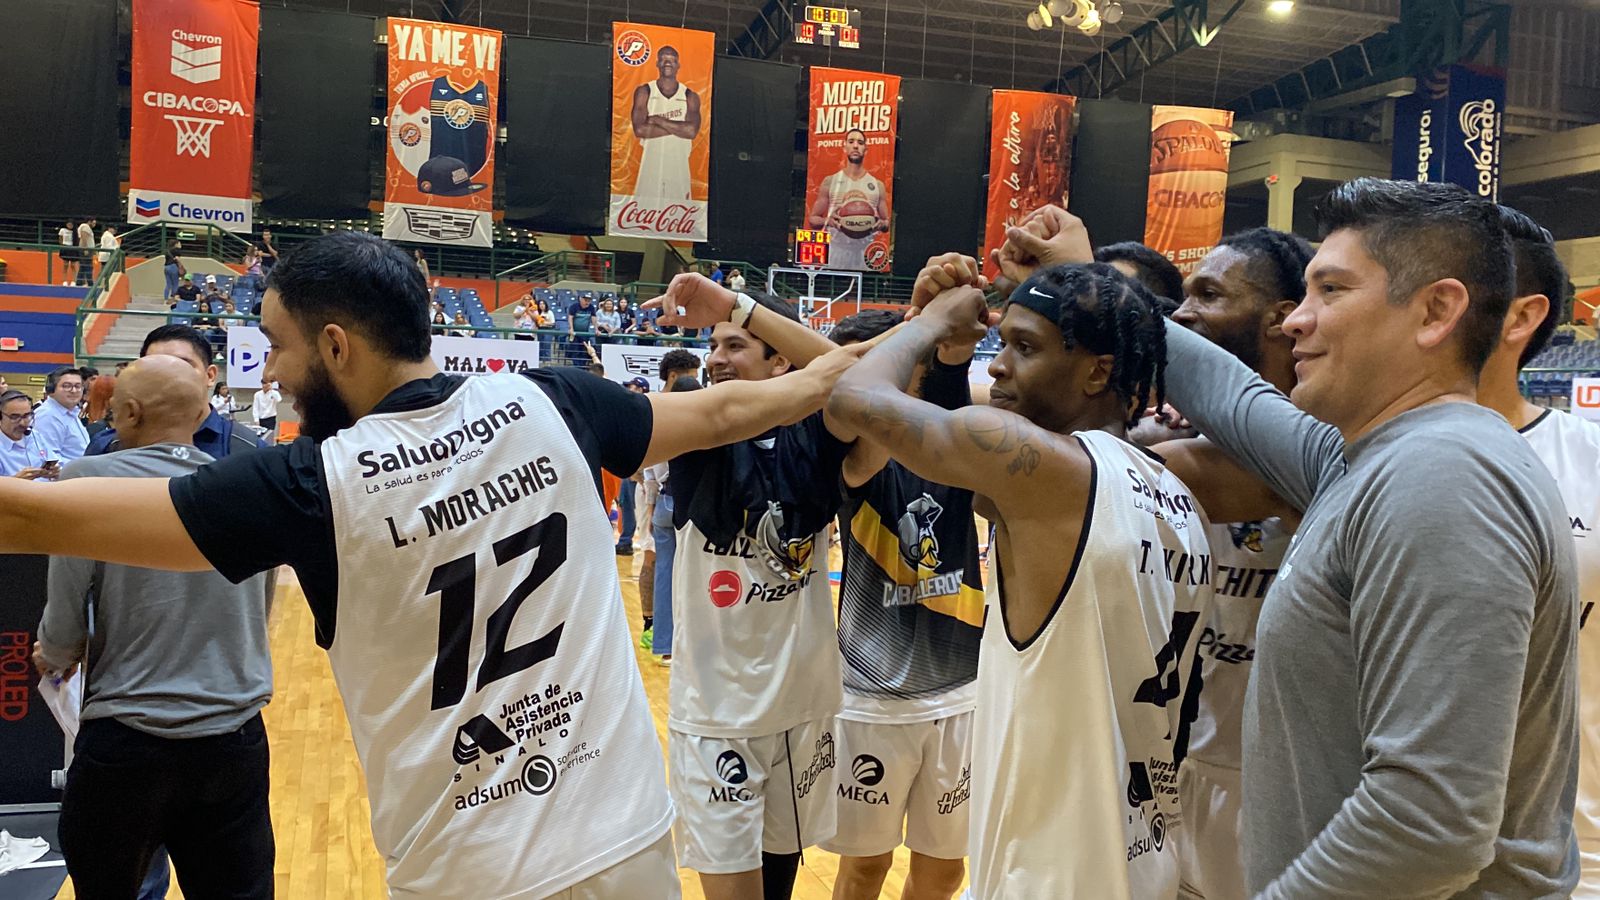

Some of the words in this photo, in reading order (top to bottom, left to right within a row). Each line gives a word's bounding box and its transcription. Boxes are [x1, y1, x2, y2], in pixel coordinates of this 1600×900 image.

[172, 29, 222, 44] Chevron
[393, 24, 427, 62] YA
[432, 28, 467, 67] ME
[473, 33, 497, 71] VI
[143, 91, 245, 116] CIBACOPA
[822, 80, 885, 106] MUCHO
[815, 105, 892, 134] MOCHIS
[817, 139, 842, 148] PONTE
[1003, 111, 1023, 166] altura
[1474, 98, 1495, 197] colorado
[1003, 172, 1021, 191] la
[168, 202, 245, 223] Chevron
[617, 201, 700, 234] Coca-Cola
[1009, 198, 1019, 210] a
[802, 244, 825, 264] 09
[366, 483, 381, 495] La
[384, 474, 413, 490] salud
[416, 471, 429, 482] es
[431, 465, 453, 481] para
[384, 516, 417, 549] L.
[418, 455, 559, 538] MORACHIS
[1139, 539, 1154, 575] T.
[745, 582, 798, 604] Pizza
[425, 511, 568, 711] 12
[0, 631, 29, 721] PROLED
[500, 692, 541, 720] Junta
[544, 683, 561, 699] de
[506, 690, 584, 733] Asistencia
[515, 712, 572, 743] Privada
[454, 728, 569, 783] SINALO
[836, 782, 889, 805] MEGA
